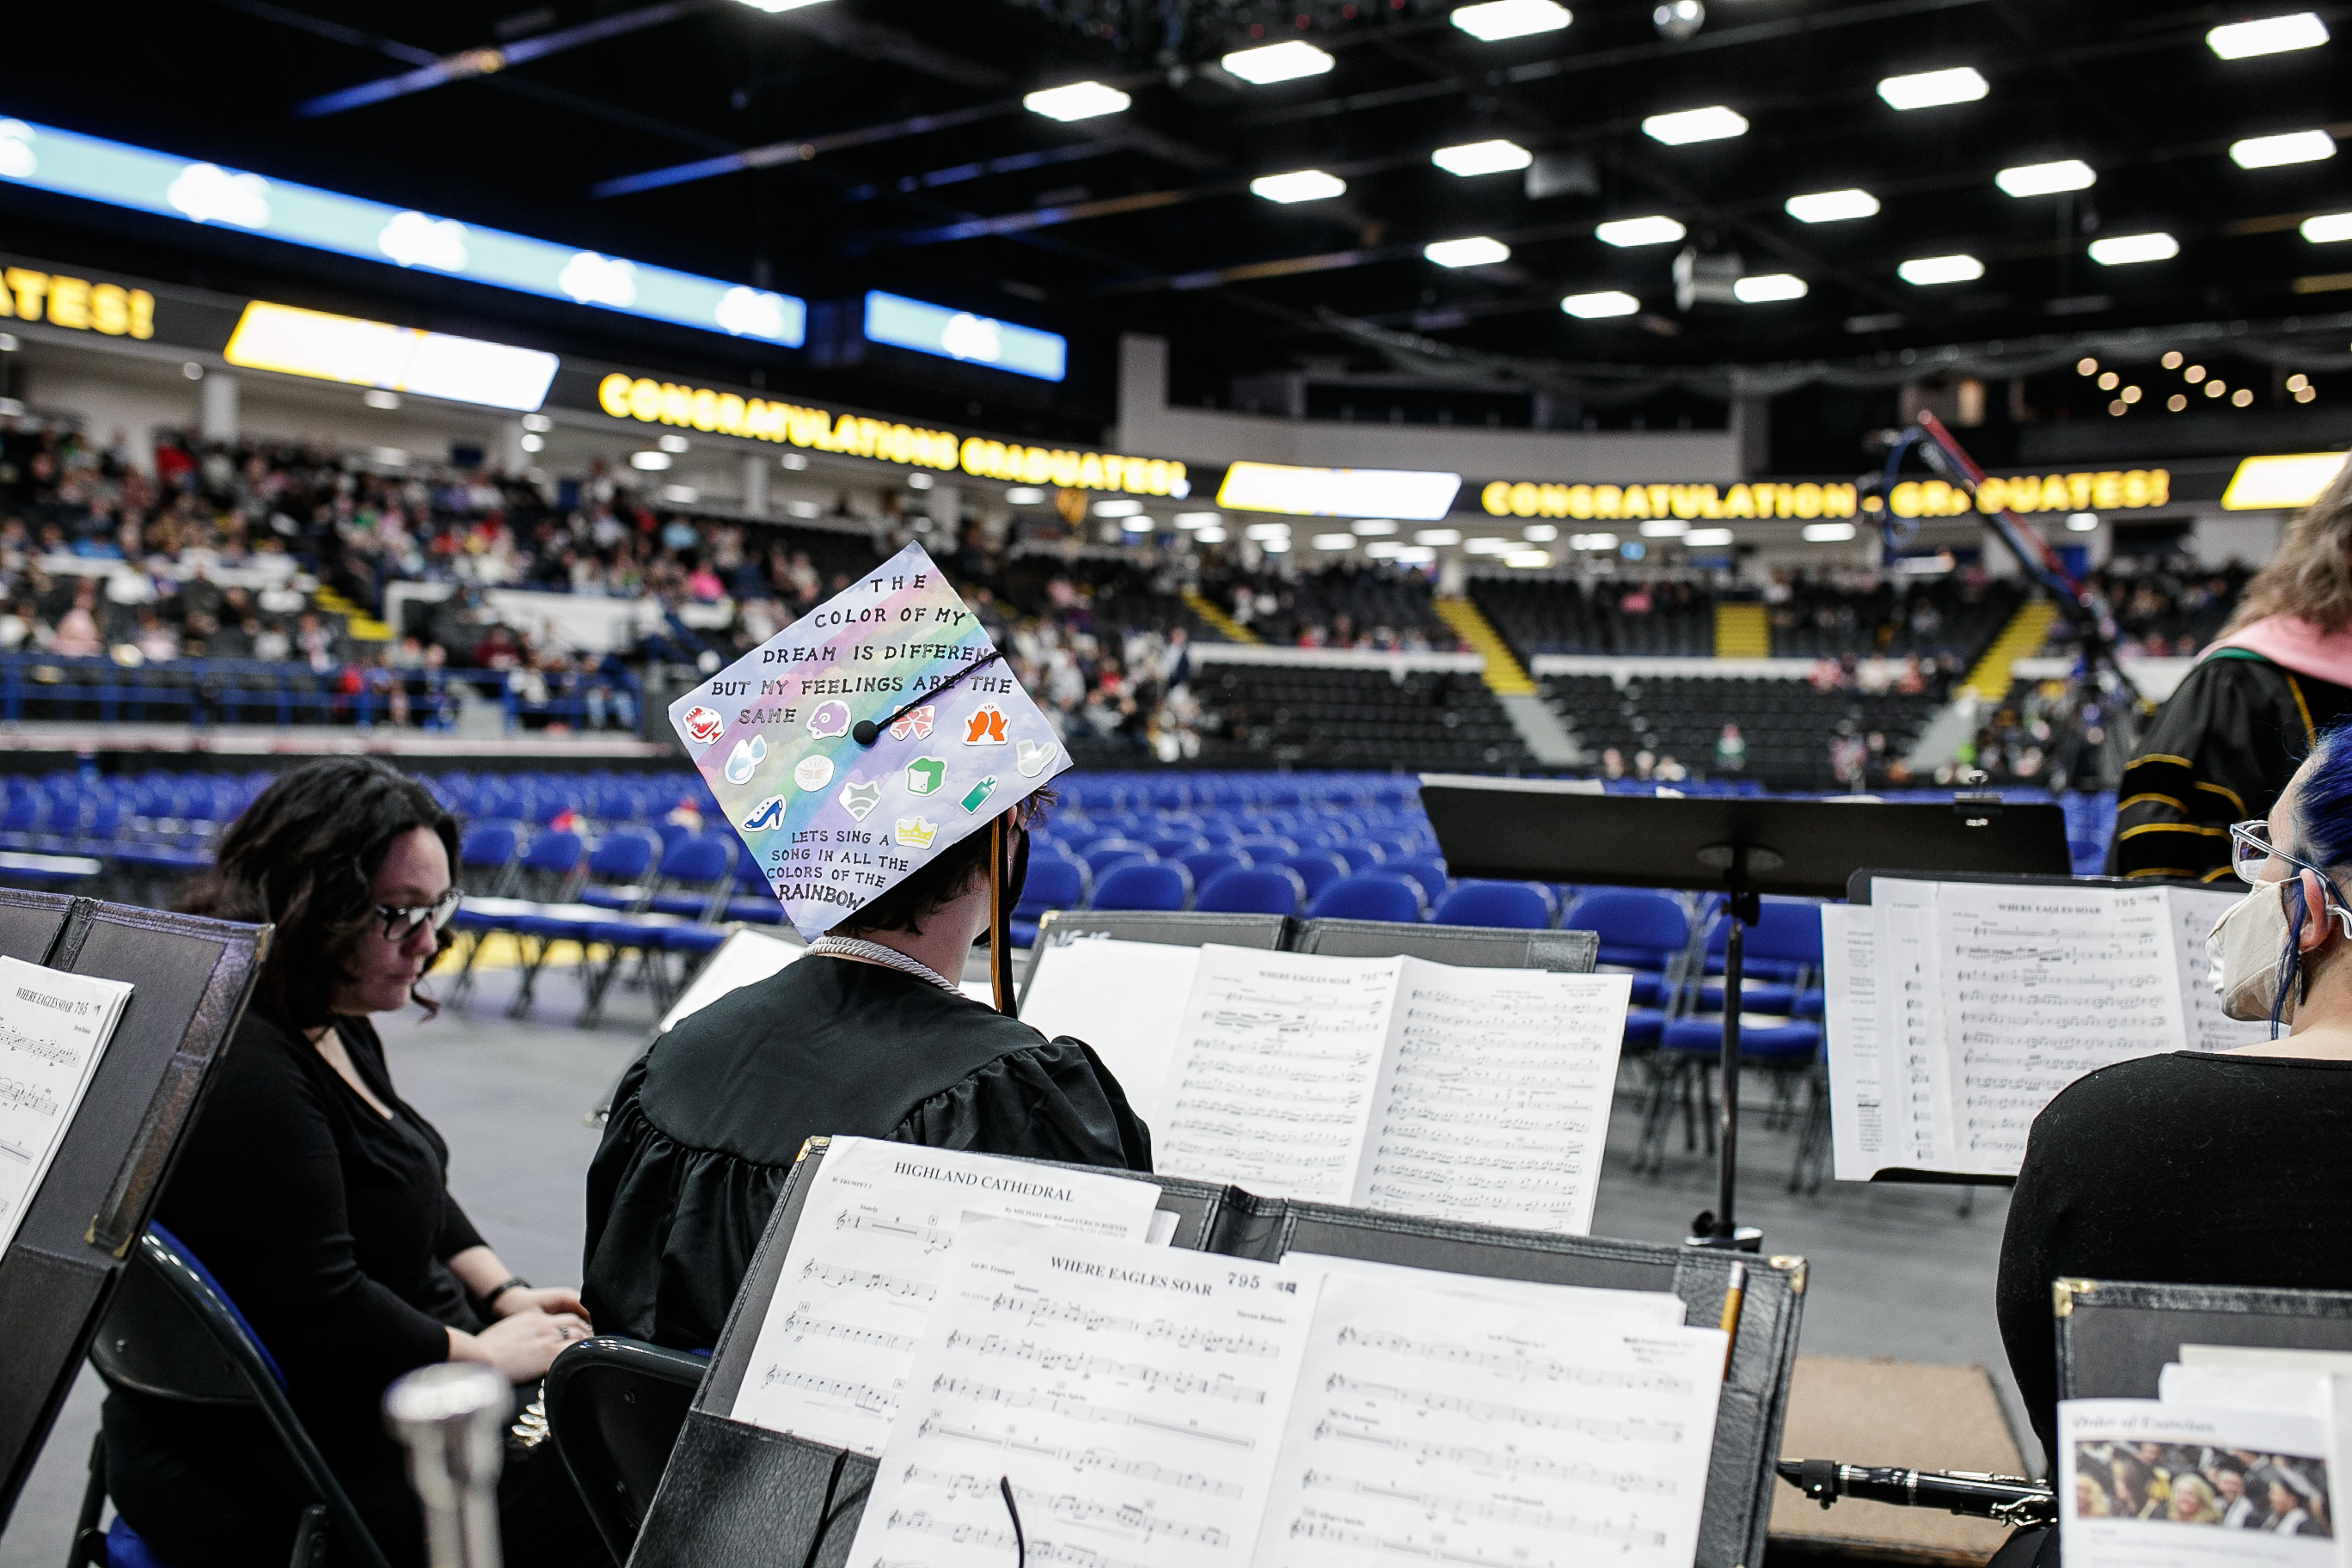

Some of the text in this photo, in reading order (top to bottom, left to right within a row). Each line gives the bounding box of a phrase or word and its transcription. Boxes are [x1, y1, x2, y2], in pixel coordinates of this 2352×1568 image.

[598, 372, 959, 470] CONGRATULATIONS
[870, 574, 927, 592] THE
[815, 607, 966, 628] COLOR OF MY
[763, 646, 837, 664] DREAM
[853, 645, 874, 661] IS
[711, 681, 751, 696] BUT
[760, 679, 789, 695] MY
[801, 676, 903, 695] FEELINGS
[970, 675, 1013, 695] THE
[738, 707, 797, 725] SAME
[791, 830, 890, 847] LETS SING A
[771, 848, 910, 873] SONG IN ALL THE
[766, 866, 886, 889] COLORS OF THE
[778, 883, 866, 911] RAINBOW
[15, 987, 89, 1016] WHERE EAGLES SOAR 795
[839, 1178, 868, 1189] TRUMPET
[893, 1161, 1075, 1204] HIGHLAND CATHEDRAL
[859, 1204, 879, 1214] Stately
[1013, 1208, 1043, 1219] MICHAEL
[1050, 1256, 1213, 1296] WHERE EAGLES SOAR
[1228, 1271, 1261, 1289] 795
